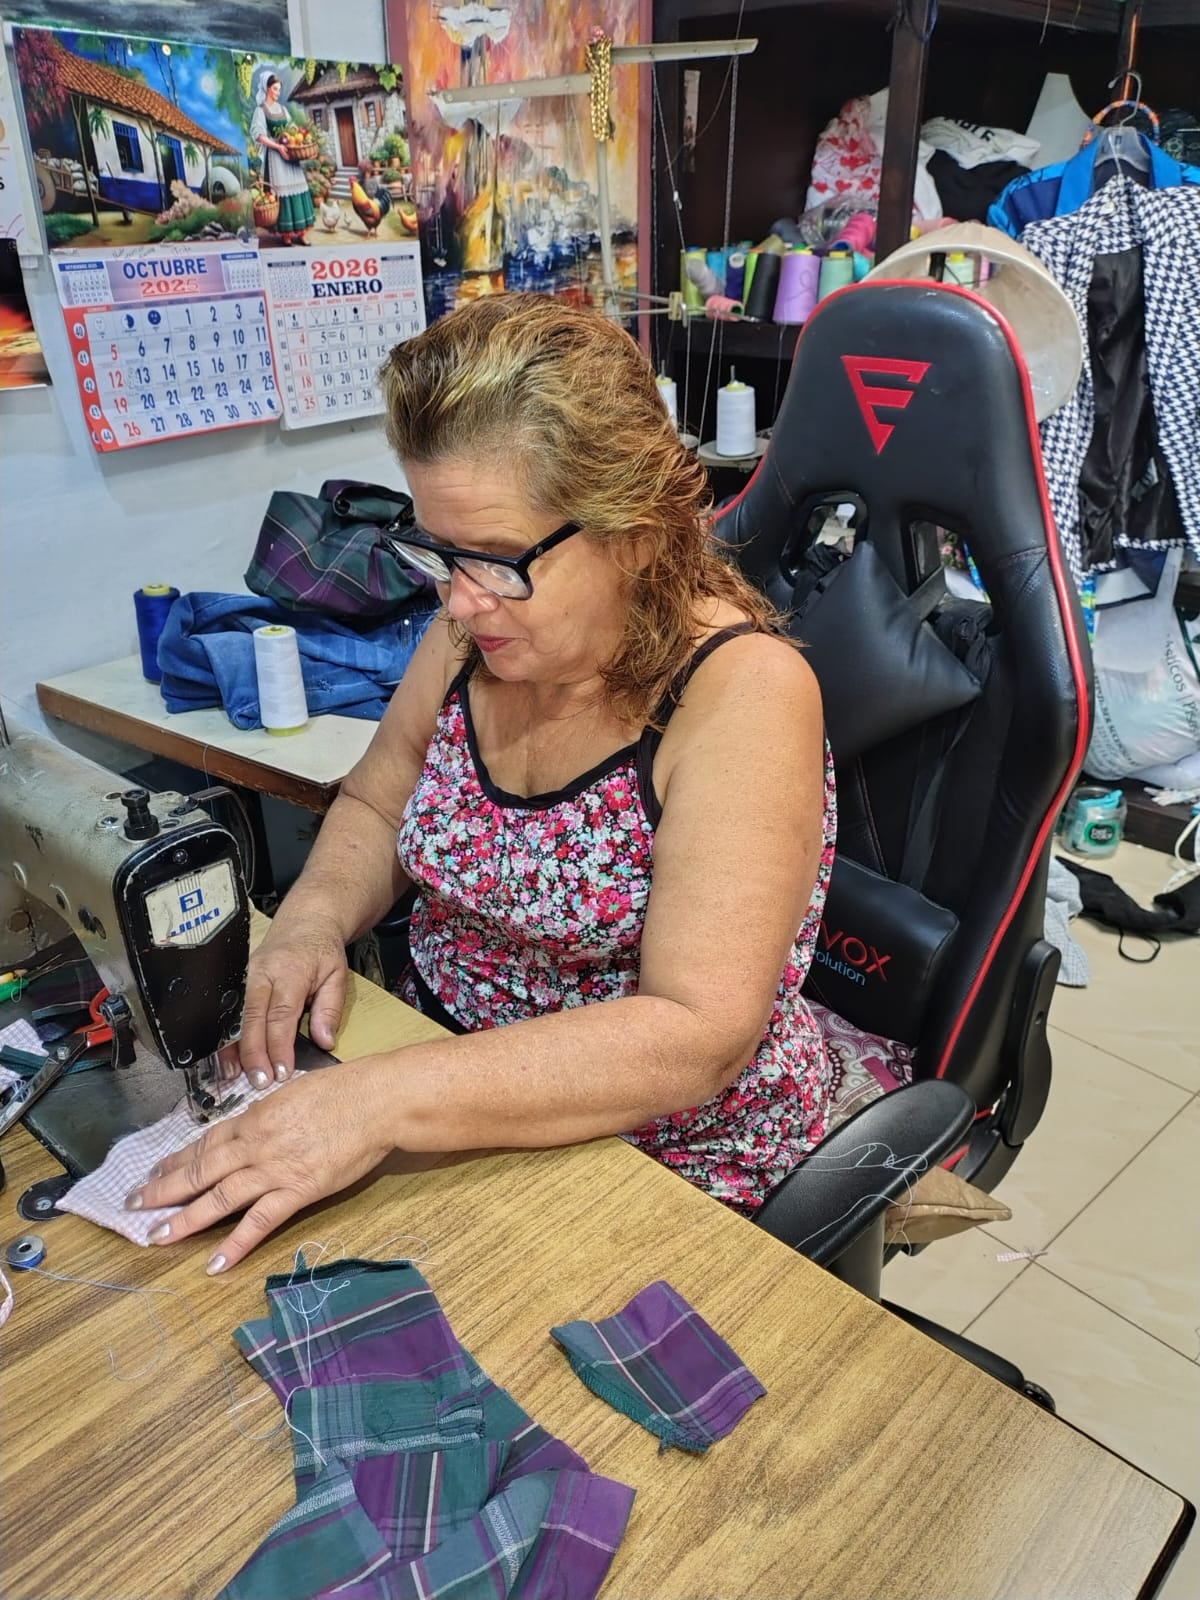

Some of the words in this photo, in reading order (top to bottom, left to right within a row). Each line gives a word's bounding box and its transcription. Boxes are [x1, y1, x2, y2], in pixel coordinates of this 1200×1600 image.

[123, 258, 207, 279] OCTUBRE
[311, 258, 378, 280] 2026
[141, 279, 198, 295] 2025
[312, 279, 383, 298] ENERO
[185, 308, 191, 325] 1
[210, 306, 217, 322] 2
[235, 304, 242, 319] 3
[259, 301, 265, 317] 4
[111, 344, 118, 360] 5
[138, 341, 146, 357] 6
[163, 338, 170, 354] 7
[189, 334, 196, 351] 8
[213, 332, 220, 347] 9
[233, 329, 244, 345] 10
[256, 326, 266, 342] 11
[321, 330, 327, 344] 5
[339, 328, 345, 341] 6
[359, 325, 364, 339] 7
[378, 323, 384, 337] 8
[395, 322, 401, 334] 9
[410, 320, 420, 333] 10
[299, 353, 308, 367] 11
[320, 352, 330, 366] 12
[338, 350, 348, 363] 13
[357, 346, 367, 360] 14
[377, 345, 386, 358] 15
[109, 370, 123, 389] 12
[136, 367, 151, 384] 13
[162, 363, 176, 380] 14
[187, 360, 200, 377] 15
[211, 357, 225, 373] 16
[236, 354, 247, 370] 17
[259, 351, 271, 367] 18
[302, 375, 312, 389] 18
[322, 373, 333, 387] 19
[340, 372, 351, 385] 20
[359, 368, 369, 381] 21
[114, 397, 128, 414] 19
[140, 393, 155, 409] 20
[166, 389, 180, 406] 21
[191, 386, 205, 401] 22
[215, 382, 229, 397] 23
[239, 378, 252, 394] 24
[262, 375, 274, 391] 25
[304, 397, 315, 410] 25
[325, 395, 336, 408] 26
[343, 392, 353, 405] 27
[362, 388, 373, 401] 28
[123, 421, 141, 437] 26
[150, 417, 166, 432] 27
[176, 412, 193, 428] 28
[200, 408, 215, 423] 29
[224, 404, 240, 419] 30
[248, 400, 262, 416] 31
[170, 907, 220, 937] JUKI
[814, 951, 866, 986] olution
